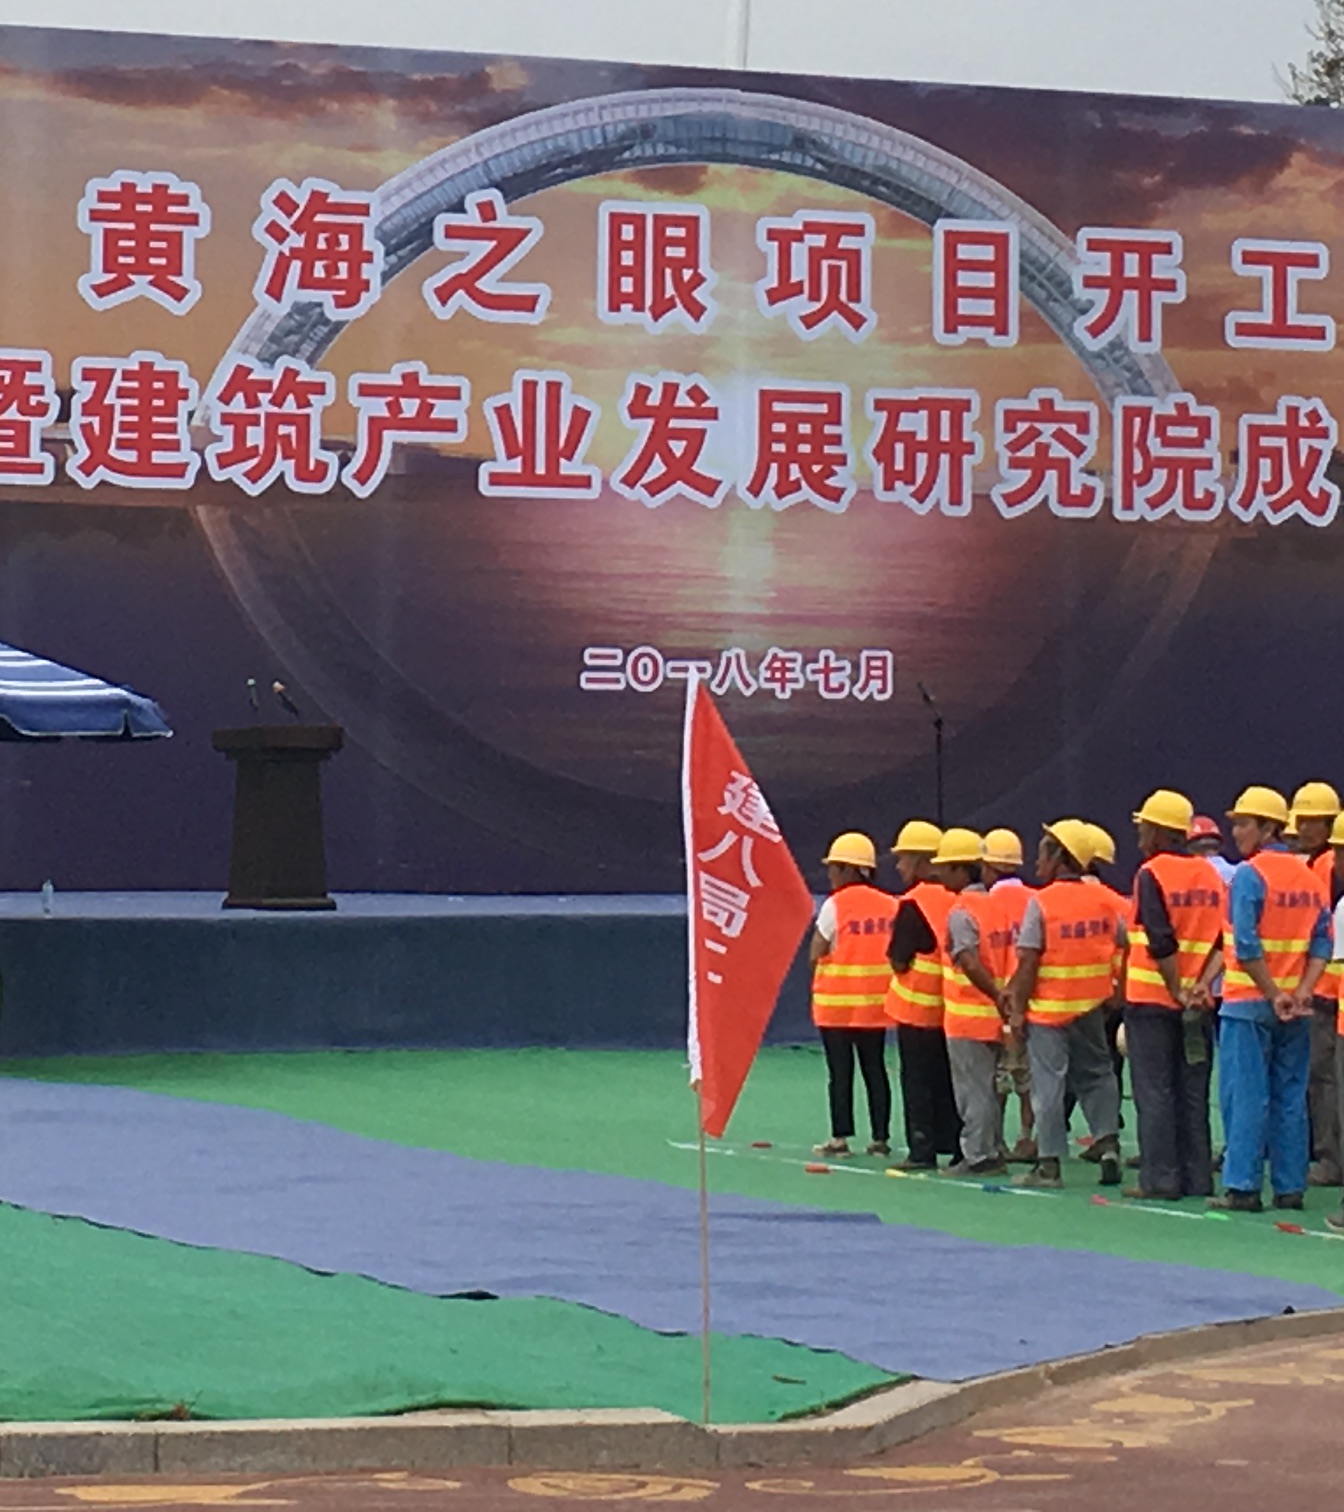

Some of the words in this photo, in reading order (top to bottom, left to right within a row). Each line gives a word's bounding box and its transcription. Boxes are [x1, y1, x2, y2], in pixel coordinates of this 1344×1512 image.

[86, 178, 1330, 345] 黄海之眼项目开工
